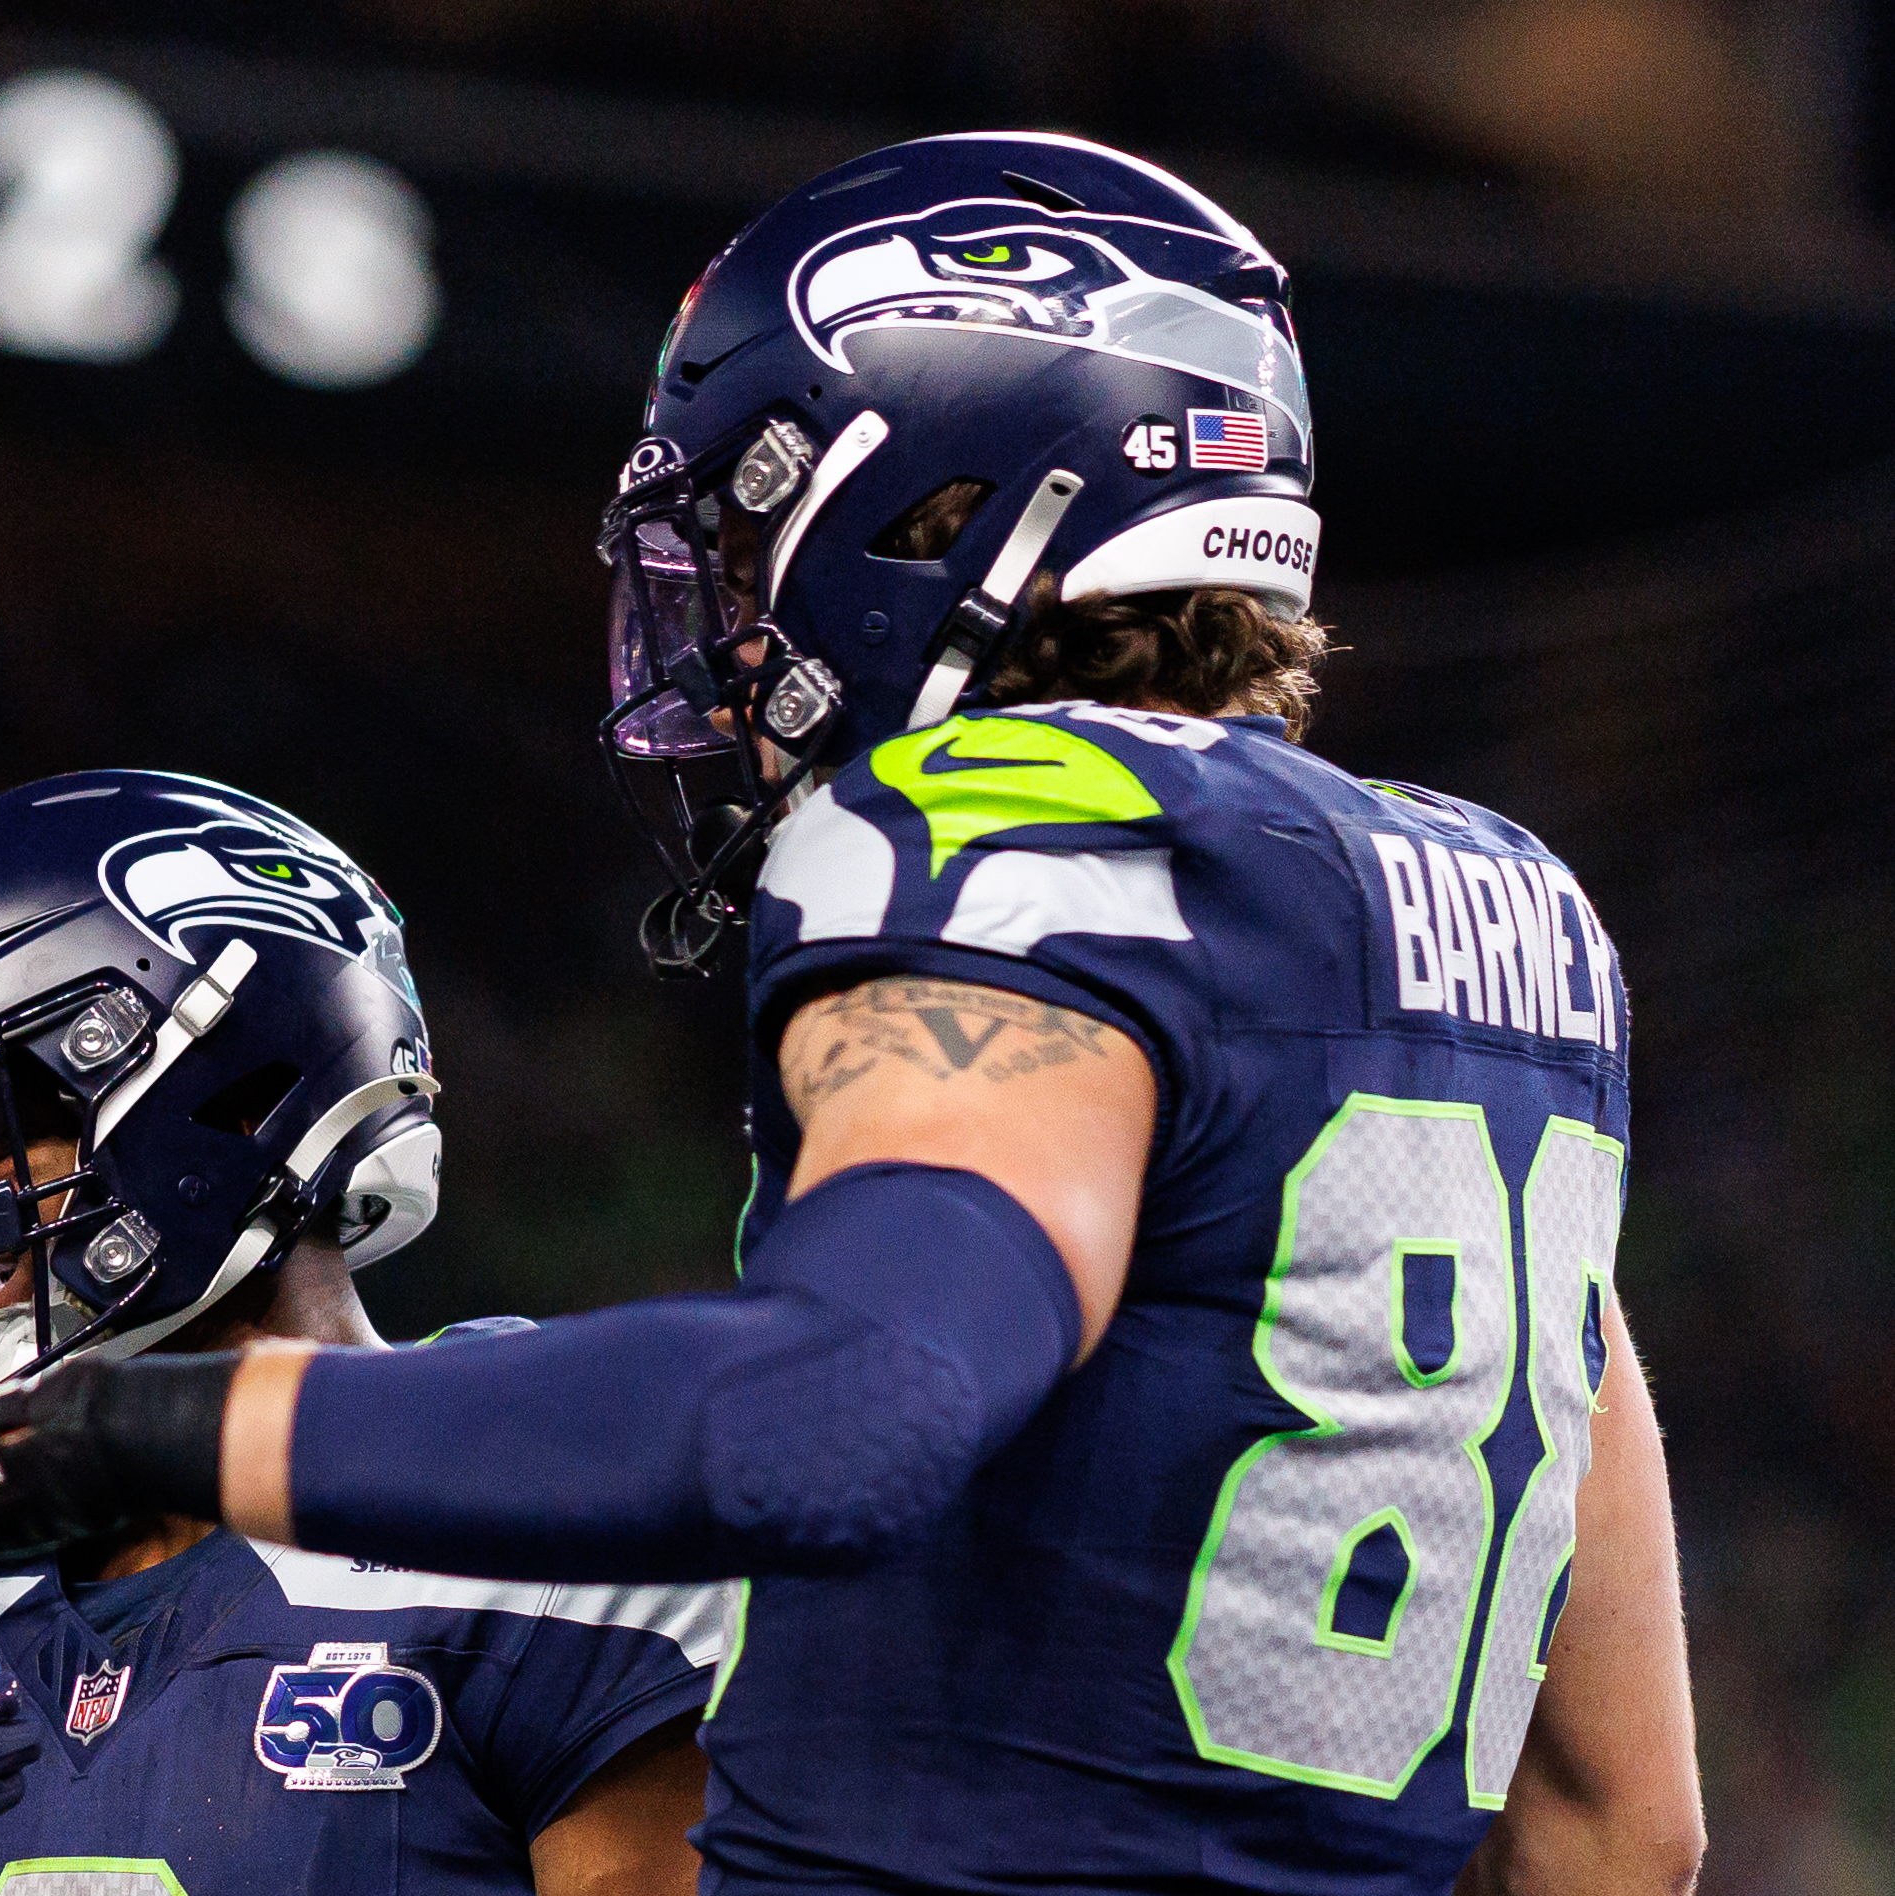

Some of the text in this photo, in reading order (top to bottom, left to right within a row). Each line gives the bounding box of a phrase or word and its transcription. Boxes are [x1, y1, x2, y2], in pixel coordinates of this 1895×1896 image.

[1123, 425, 1178, 469] 45
[1203, 526, 1313, 574] CHOOSE
[73, 1696, 114, 1730] NFL
[260, 1672, 438, 1768] 50
